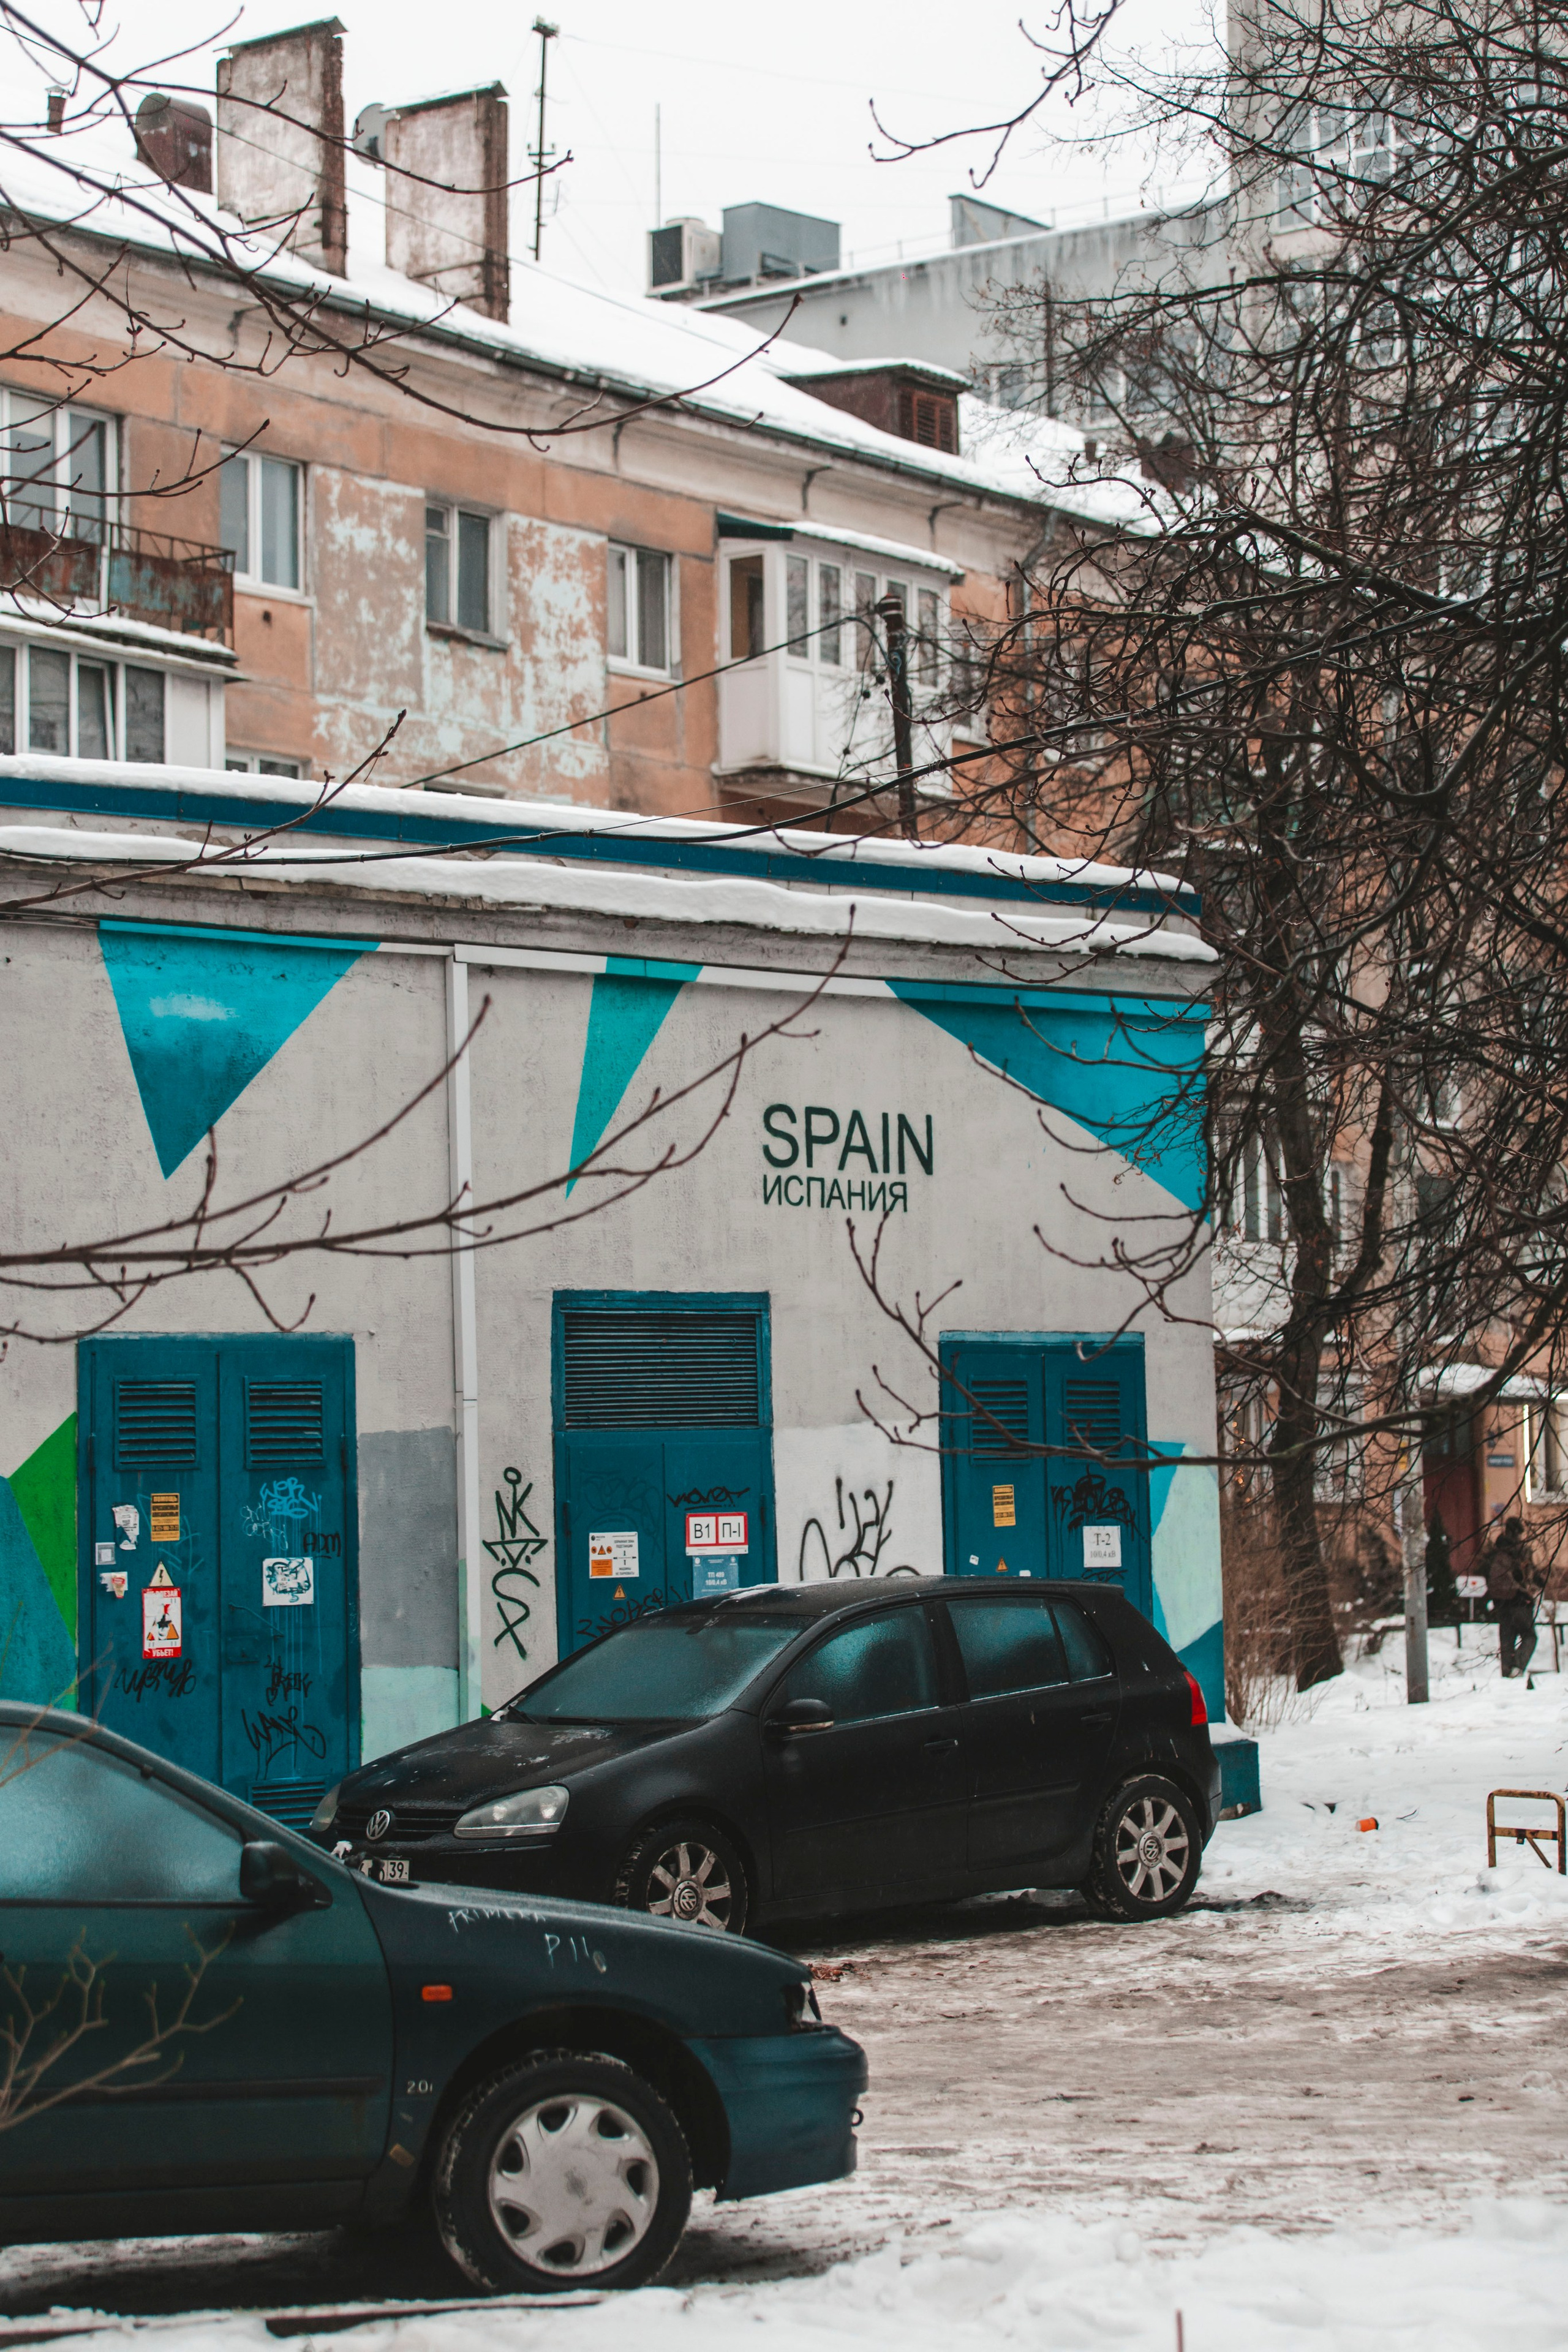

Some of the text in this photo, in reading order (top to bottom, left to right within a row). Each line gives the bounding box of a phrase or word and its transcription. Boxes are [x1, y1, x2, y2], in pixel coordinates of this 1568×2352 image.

[763, 1104, 933, 1175] SPAIN
[763, 1175, 908, 1212] ИСПАНИЯ
[695, 1523, 710, 1539] В1
[390, 1861, 404, 1879] 39
